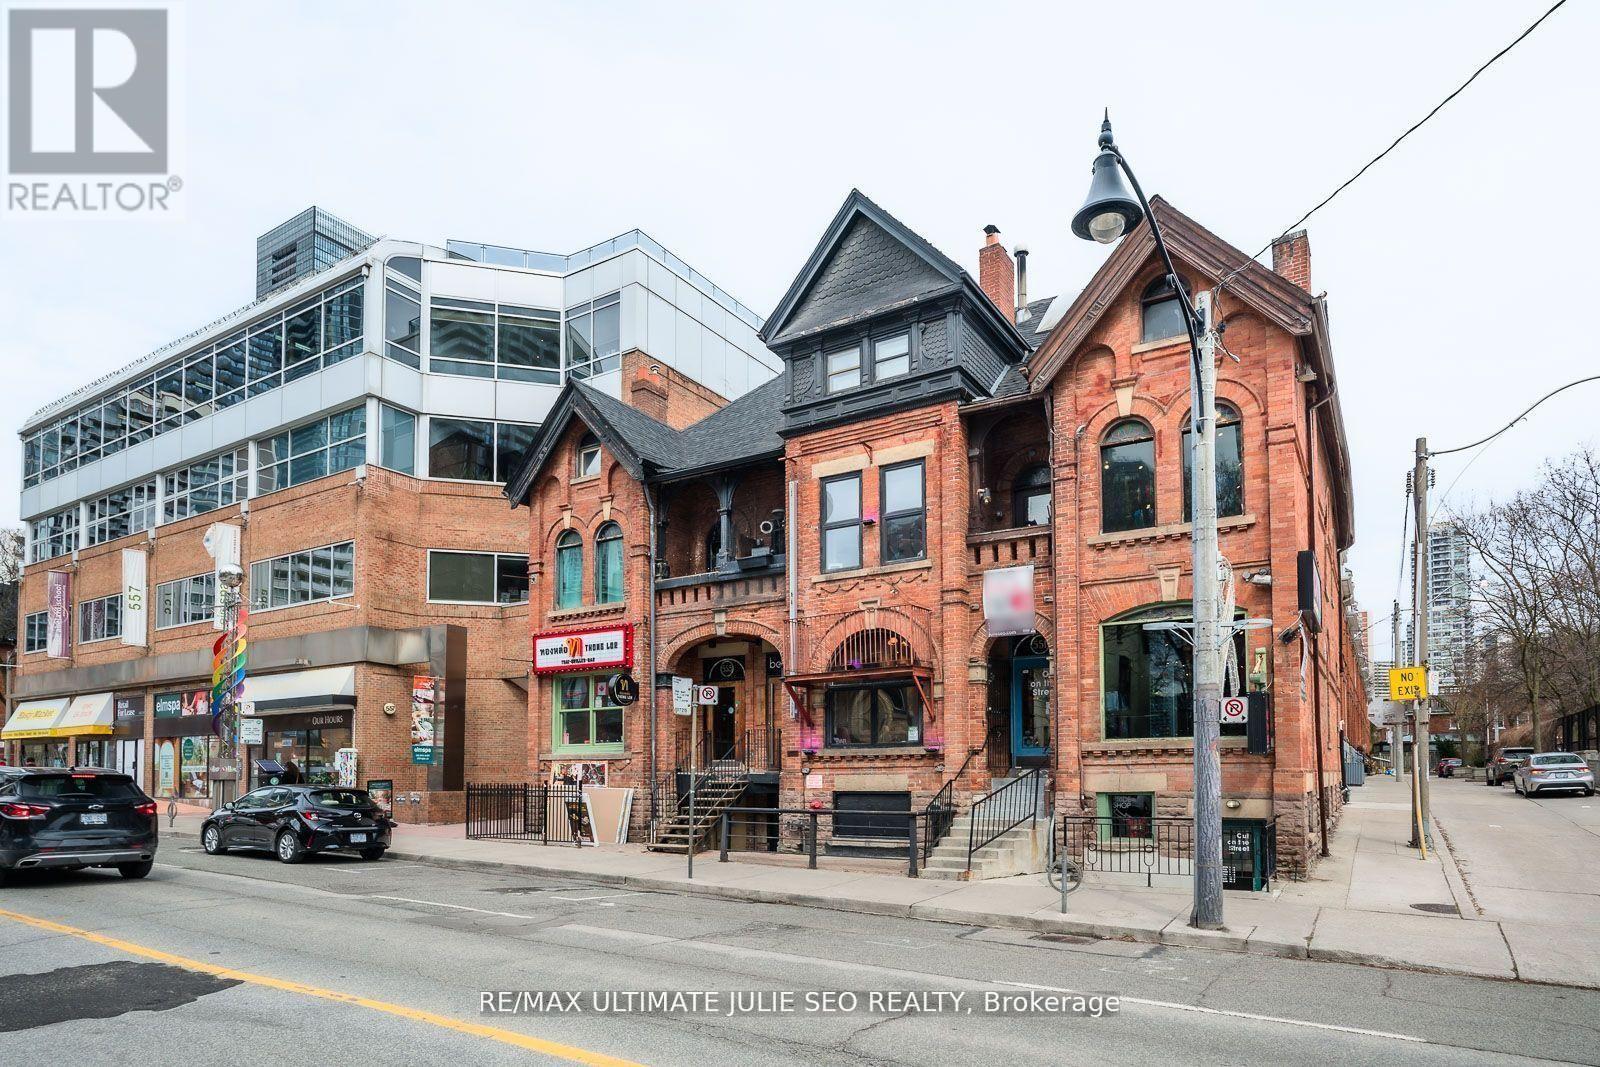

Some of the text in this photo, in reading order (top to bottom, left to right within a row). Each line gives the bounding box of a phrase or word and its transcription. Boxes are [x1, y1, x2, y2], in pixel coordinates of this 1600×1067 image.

[128, 586, 141, 610] 557
[1401, 672, 1414, 681] NO
[1032, 688, 1050, 696] Stre
[156, 699, 180, 714] elmspa
